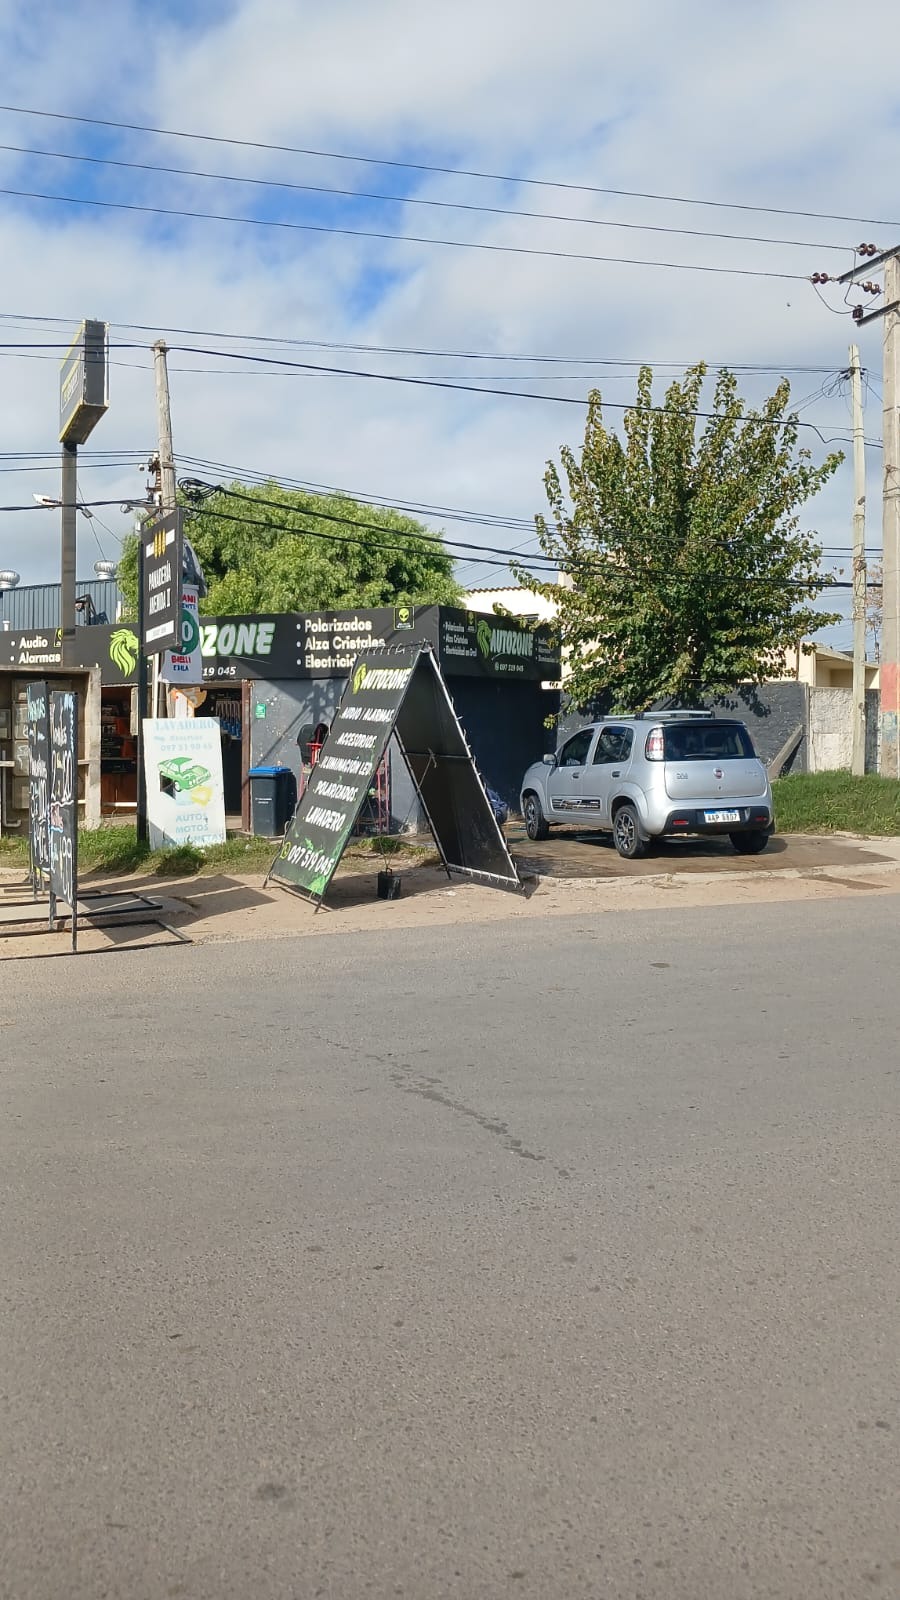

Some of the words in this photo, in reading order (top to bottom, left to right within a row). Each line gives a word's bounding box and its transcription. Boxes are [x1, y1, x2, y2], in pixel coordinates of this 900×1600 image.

[305, 616, 373, 632] Polarizados
[19, 636, 48, 649] Audio
[200, 622, 276, 657] ZONE
[304, 636, 330, 651] Alza
[332, 634, 387, 650] Cristales
[490, 628, 534, 657] AUTOZONE
[19, 652, 61, 665] Alarmas
[305, 653, 357, 669] Electricid
[202, 667, 215, 676] 19
[217, 666, 237, 676] 045
[360, 668, 413, 690] AUTOZONE
[362, 708, 395, 722] ALARMAS
[176, 813, 208, 823] AUTOS
[304, 806, 346, 832] LAVADERO
[175, 823, 209, 834] MOTOS
[287, 845, 306, 865] 097
[300, 850, 319, 871] 519
[314, 855, 336, 876] 045
